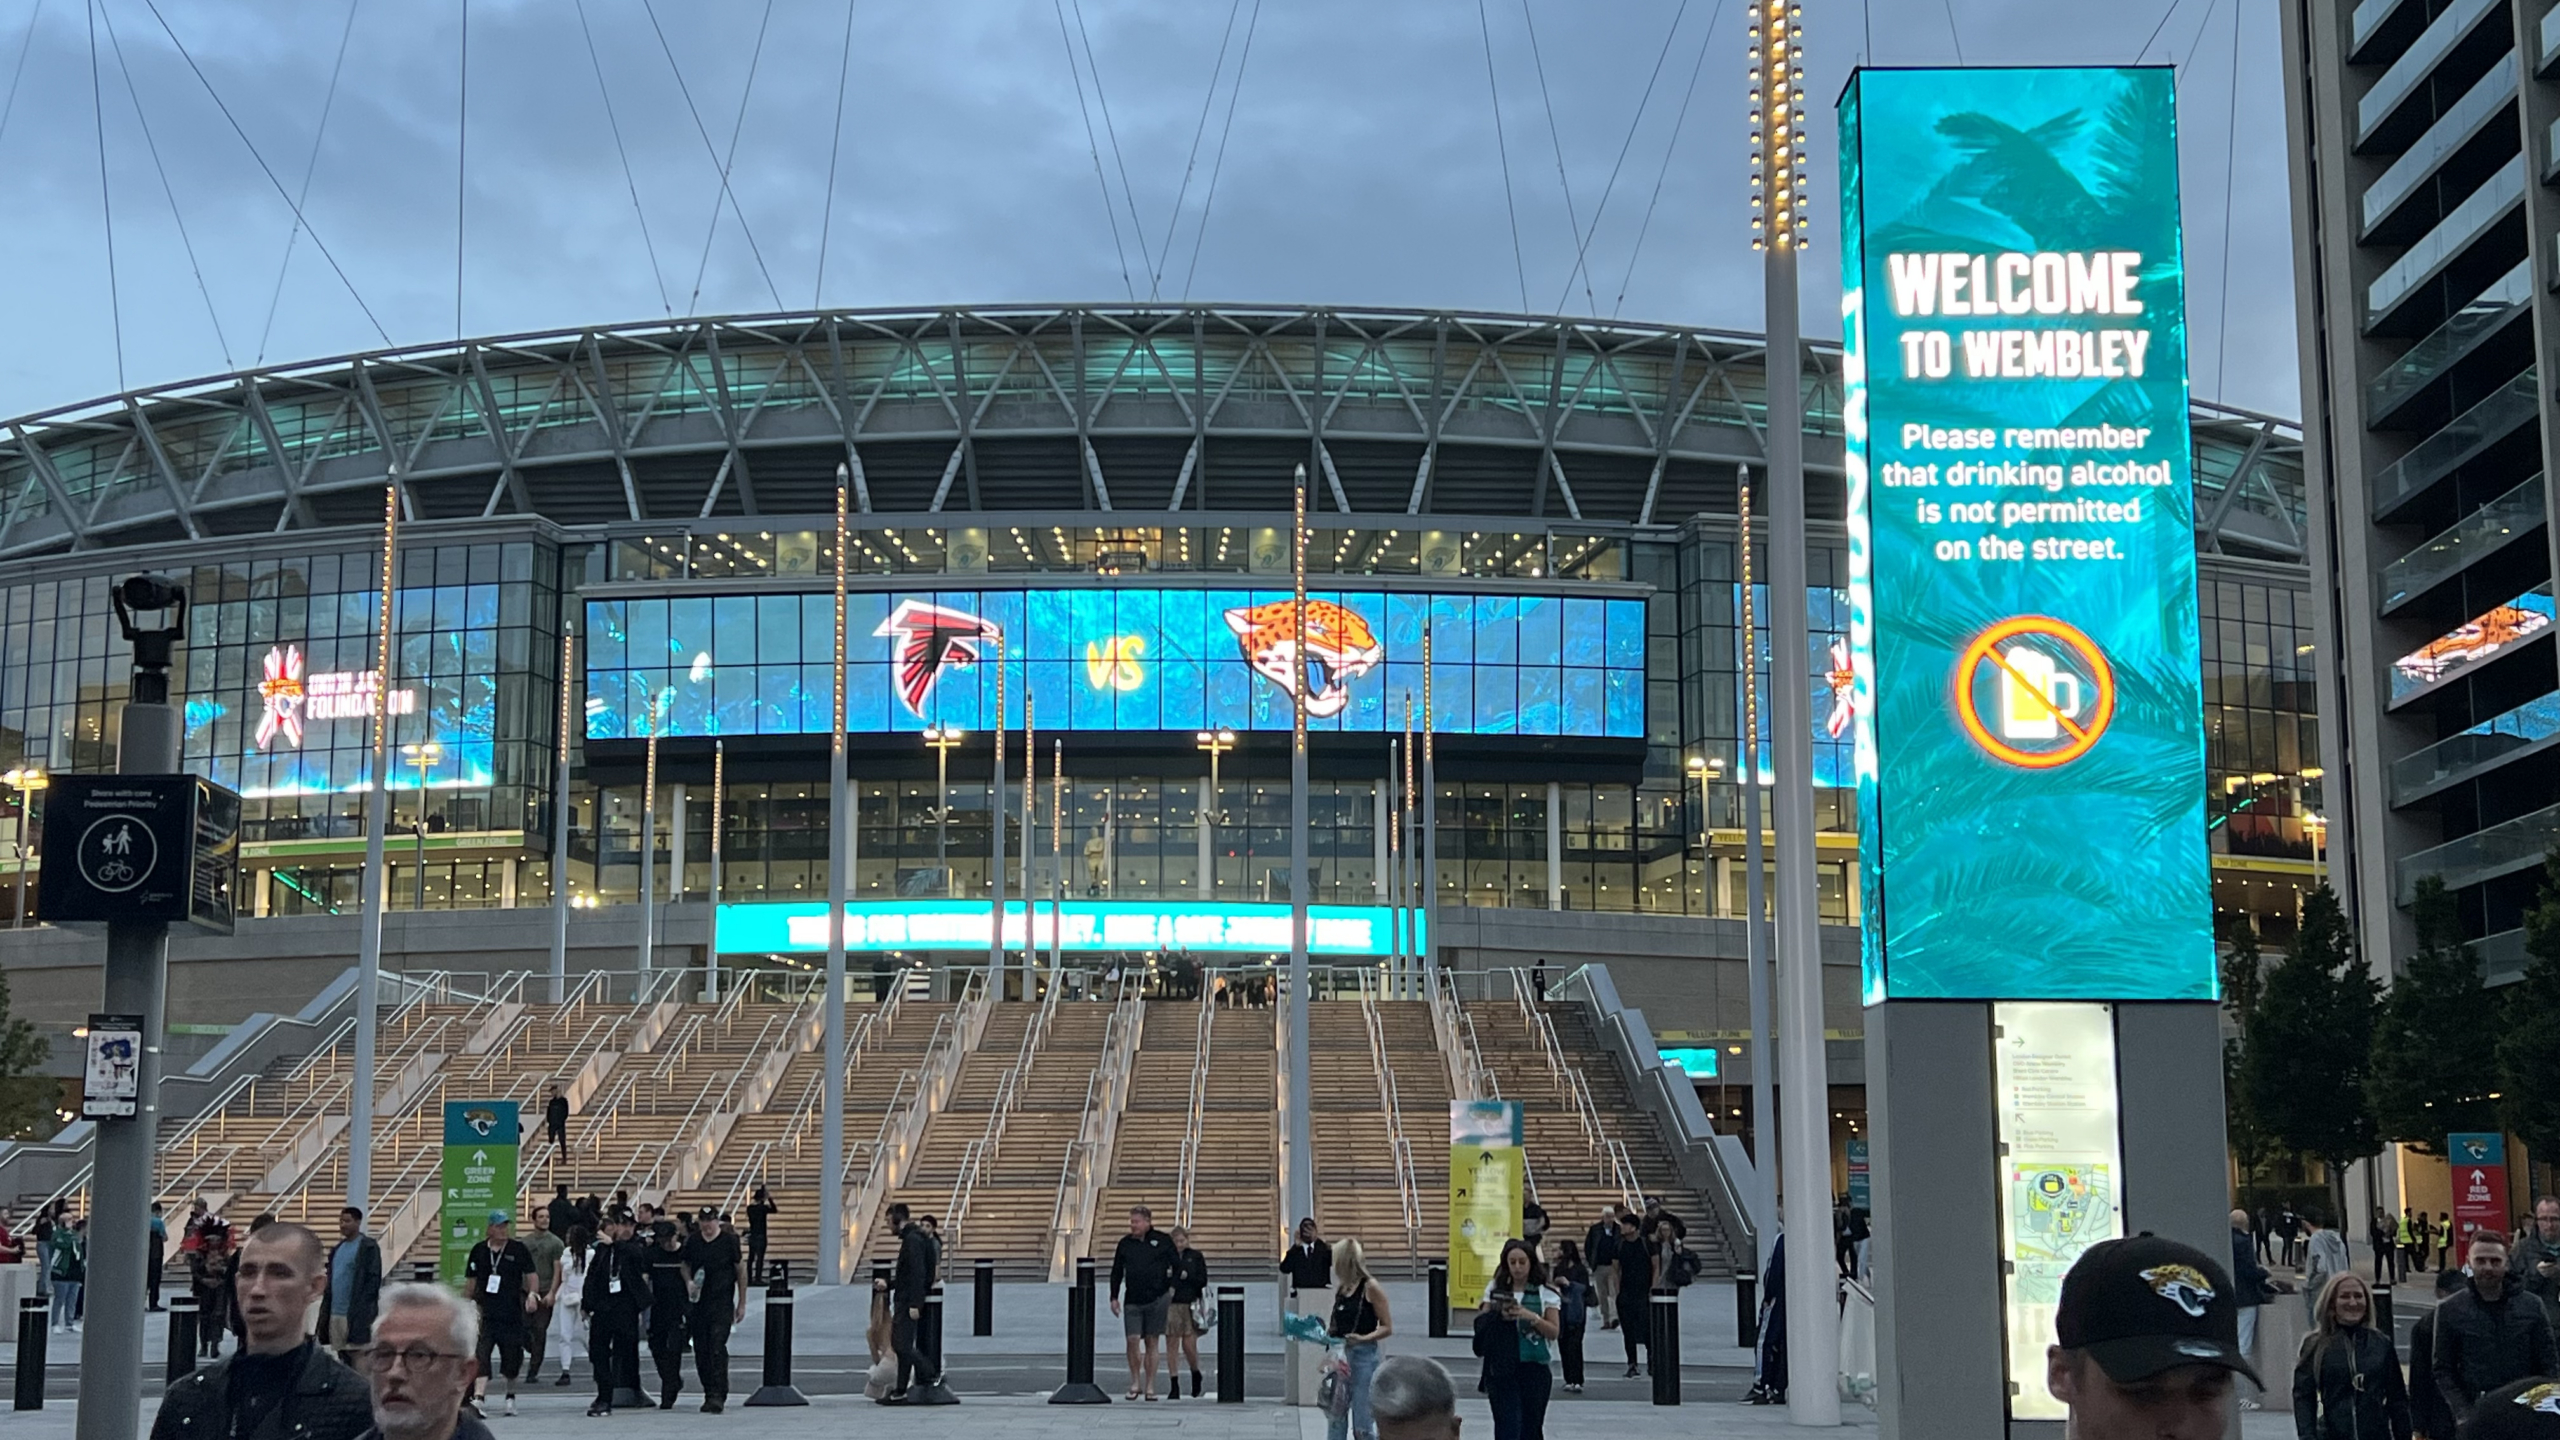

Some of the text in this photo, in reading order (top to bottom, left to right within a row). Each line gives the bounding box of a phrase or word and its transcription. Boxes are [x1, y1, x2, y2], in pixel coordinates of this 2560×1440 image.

[1888, 251, 2144, 316] WELCOME
[1900, 330, 2150, 378] TO WEMBLEY
[1902, 422, 2151, 450] Please remember
[1882, 460, 2173, 492] that drinking alcohol
[1916, 497, 2141, 529] is not permitted
[1935, 535, 2125, 561] on the street.
[1086, 635, 1145, 691] VS
[353, 670, 382, 692] JA
[306, 690, 414, 720] FOUNDAON
[91, 789, 112, 797] Share
[115, 789, 132, 797] with
[84, 800, 157, 809] Pedestrian Priority
[1718, 832, 1746, 843] YELLO
[1685, 1029, 1718, 1039] YELLOW
[464, 1167, 495, 1176] GREEN
[466, 1176, 492, 1184] ZONE
[1468, 1167, 1505, 1177] YELLOW
[1474, 1176, 1499, 1185] ZONE
